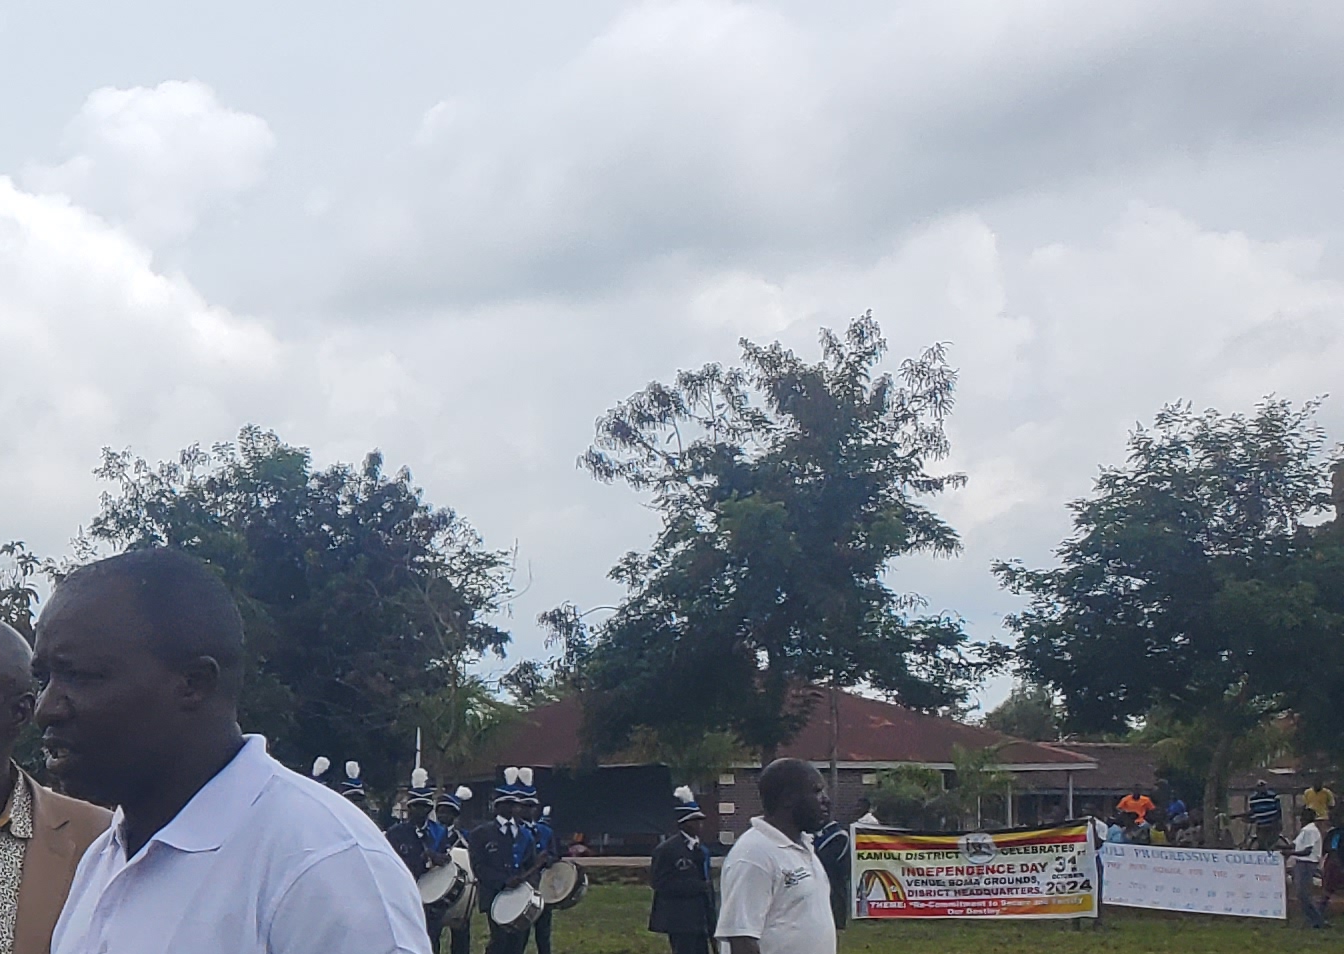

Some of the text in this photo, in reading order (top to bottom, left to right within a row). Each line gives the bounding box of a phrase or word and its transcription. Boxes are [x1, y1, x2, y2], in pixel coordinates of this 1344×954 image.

[857, 844, 1075, 861] KAMULI DISTRICT CELEBRATES
[1134, 848, 1219, 863] PROGRESSIVE
[1225, 853, 1280, 866] COLLEGE
[901, 861, 1049, 877] INDEPENDENCE DAY
[983, 875, 1041, 886] GROUNDS,
[1045, 878, 1093, 896] 2024
[907, 888, 950, 898] DISRICT
[870, 901, 906, 909] THEME:
